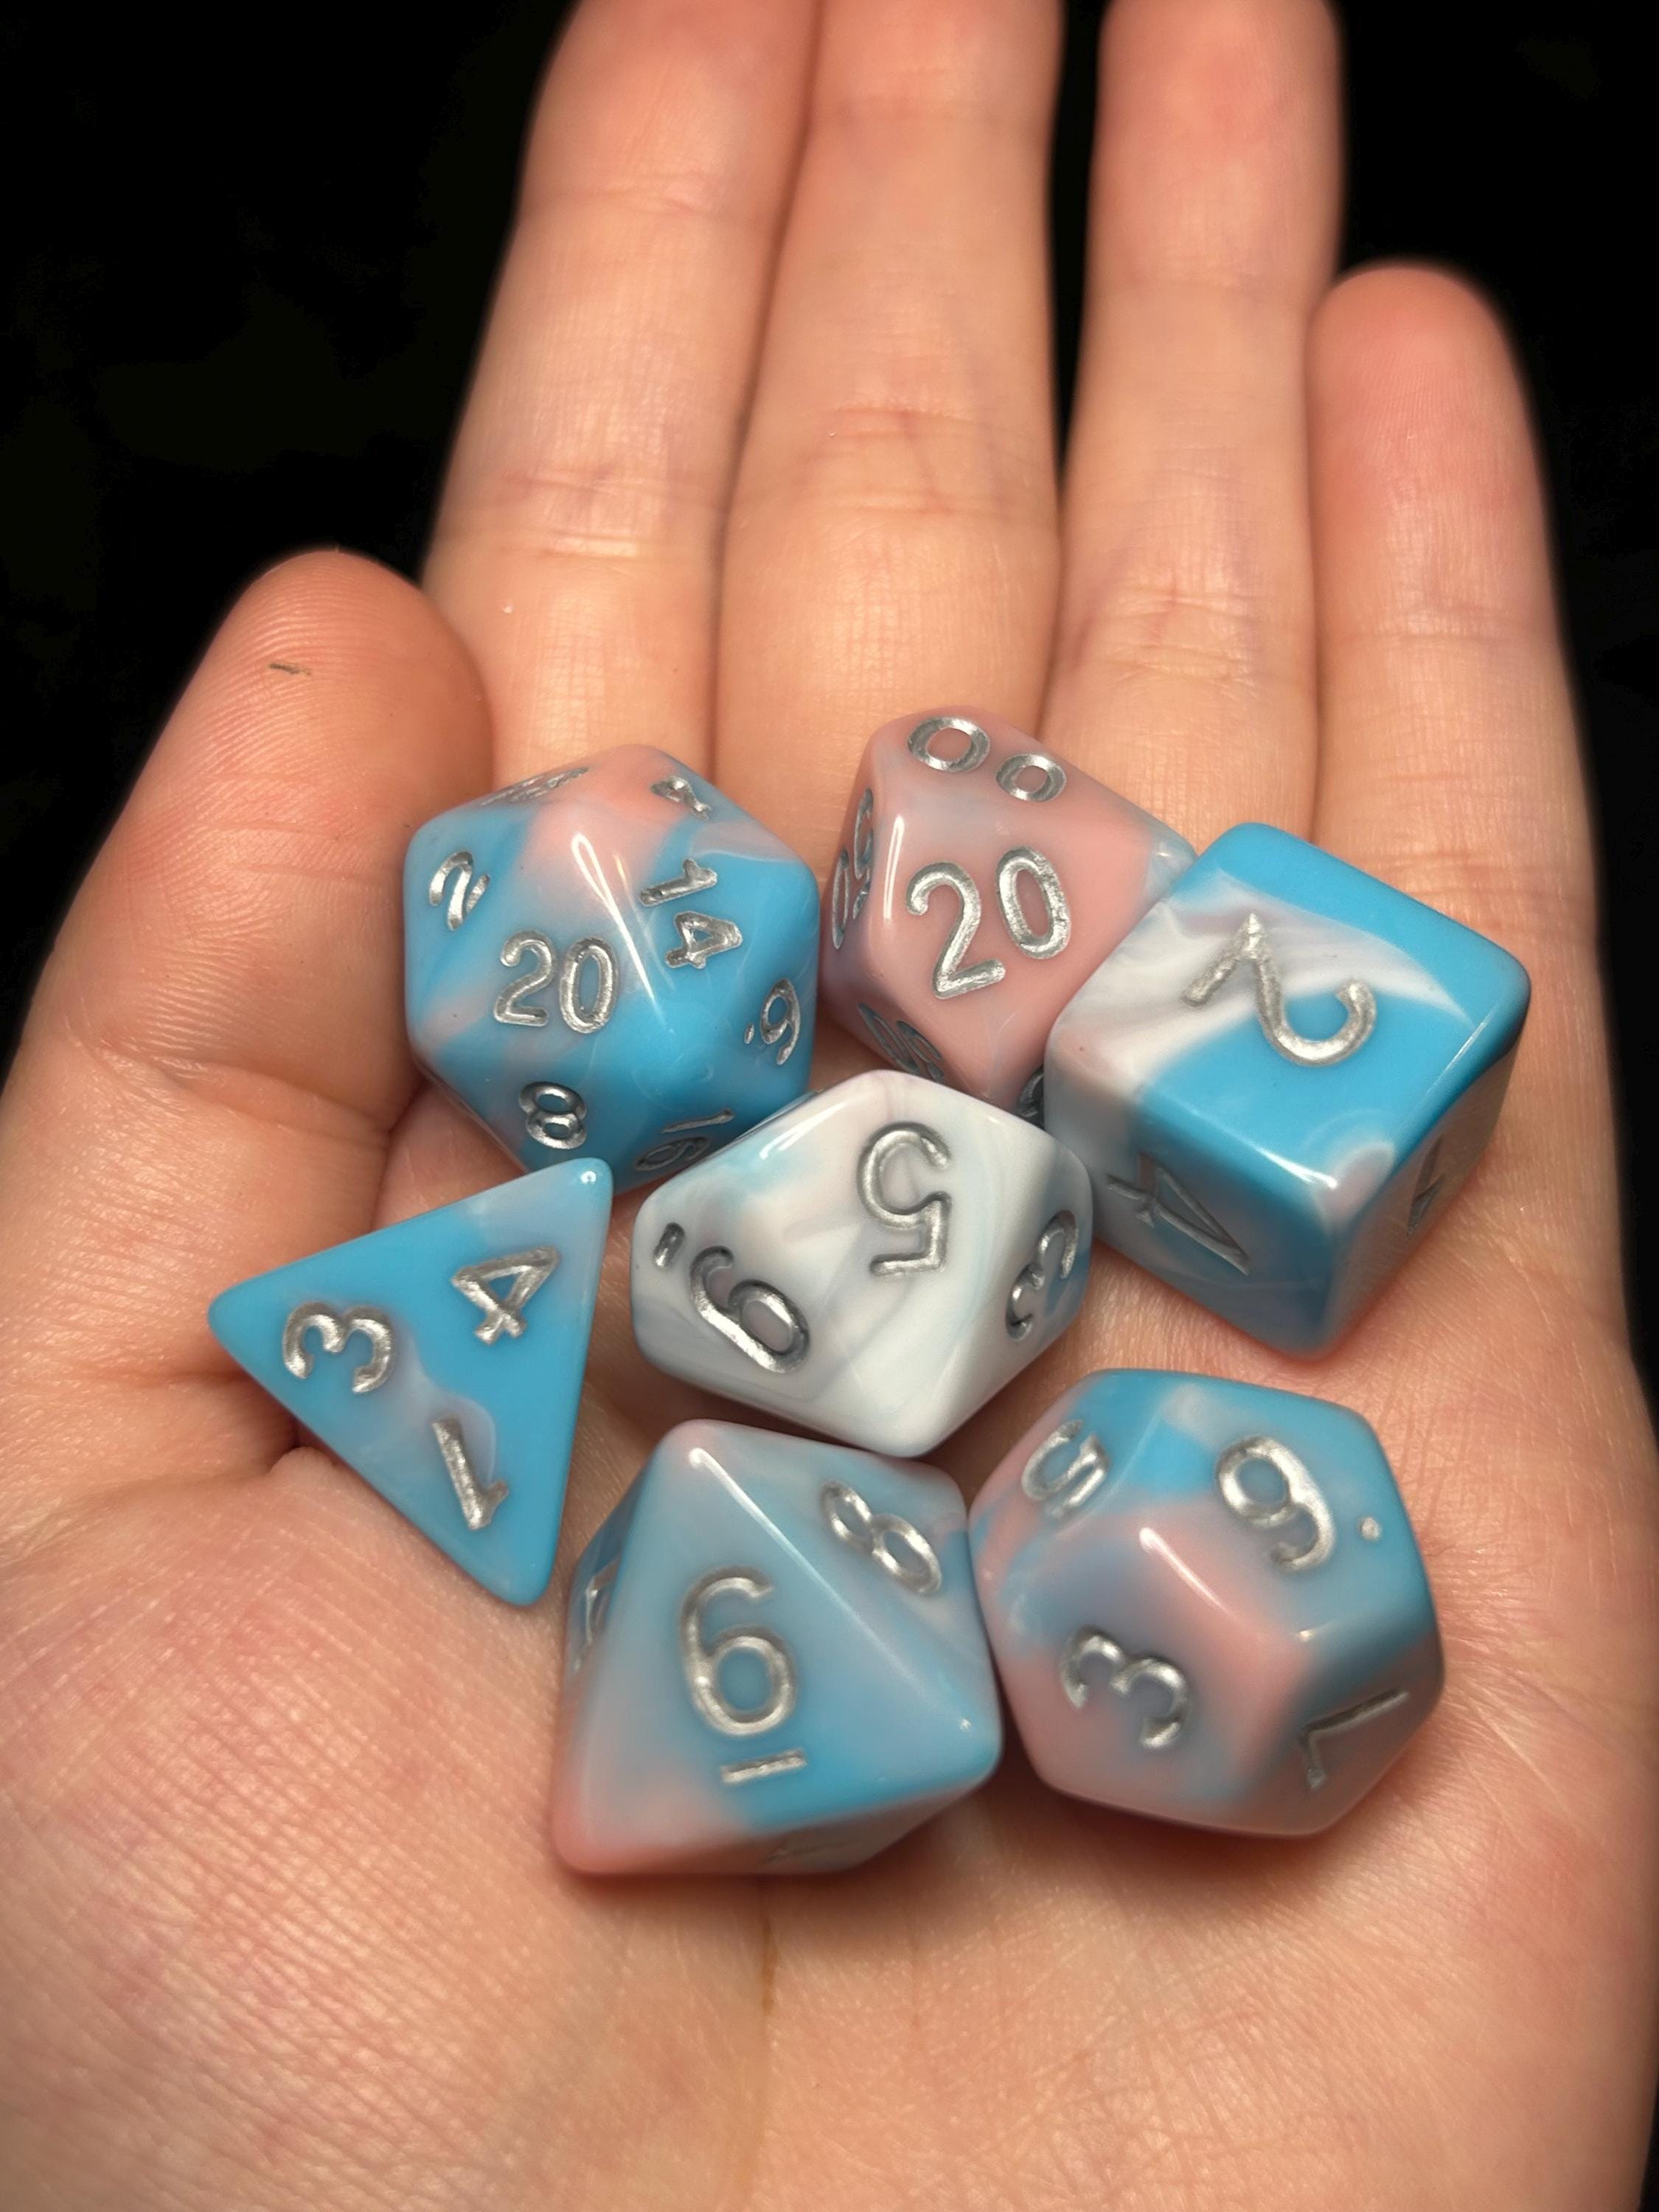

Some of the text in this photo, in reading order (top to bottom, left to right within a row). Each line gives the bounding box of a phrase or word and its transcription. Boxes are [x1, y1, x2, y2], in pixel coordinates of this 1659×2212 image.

[908, 715, 1068, 803] 00
[429, 850, 491, 931] 2
[639, 858, 744, 969] 14
[906, 846, 1072, 1000] 20
[493, 930, 617, 1034] 20
[1182, 913, 1377, 1066] 2
[519, 1080, 588, 1150] 8
[858, 1121, 952, 1277] 5
[1106, 1150, 1251, 1276] 4
[452, 1246, 561, 1346] 4
[1006, 1208, 1079, 1340] 3
[282, 1301, 397, 1393] 3
[431, 1416, 510, 1531] 1
[1021, 1419, 1109, 1520] 5
[819, 1479, 943, 1597] 8
[680, 1566, 796, 1736] 6
[1060, 1624, 1191, 1750] 3
